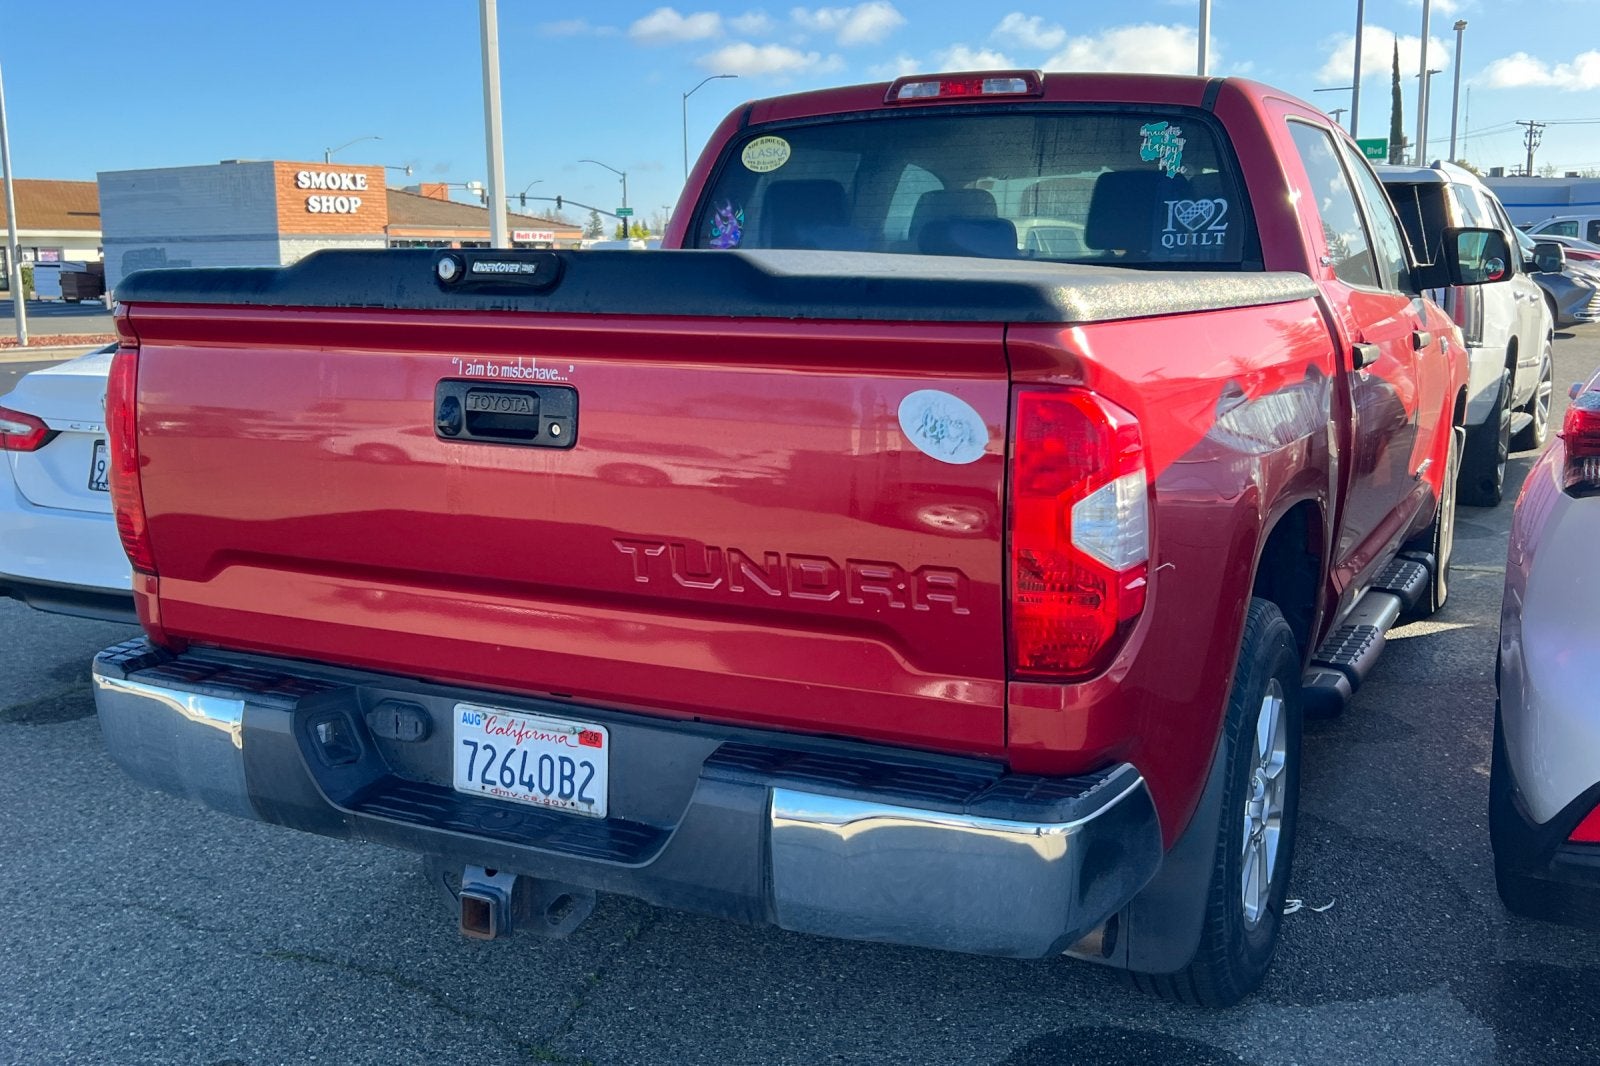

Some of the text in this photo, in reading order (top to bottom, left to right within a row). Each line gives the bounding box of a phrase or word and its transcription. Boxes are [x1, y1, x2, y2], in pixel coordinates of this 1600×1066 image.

[744, 148, 787, 160] ALASKA
[1366, 146, 1383, 155] Blvd
[296, 170, 369, 191] SMOKE
[306, 195, 362, 214] SHOP
[1207, 198, 1229, 231] 2
[1161, 232, 1226, 249] QUILT
[464, 359, 485, 377] aim
[486, 361, 500, 377] to
[469, 393, 531, 413] TOYOTA
[611, 537, 971, 615] TUNDRA
[462, 711, 481, 726] AUG
[485, 716, 578, 747] California
[589, 731, 599, 742] 26
[462, 739, 595, 804] 72640B2
[490, 788, 568, 807] dmv.ca.gov
